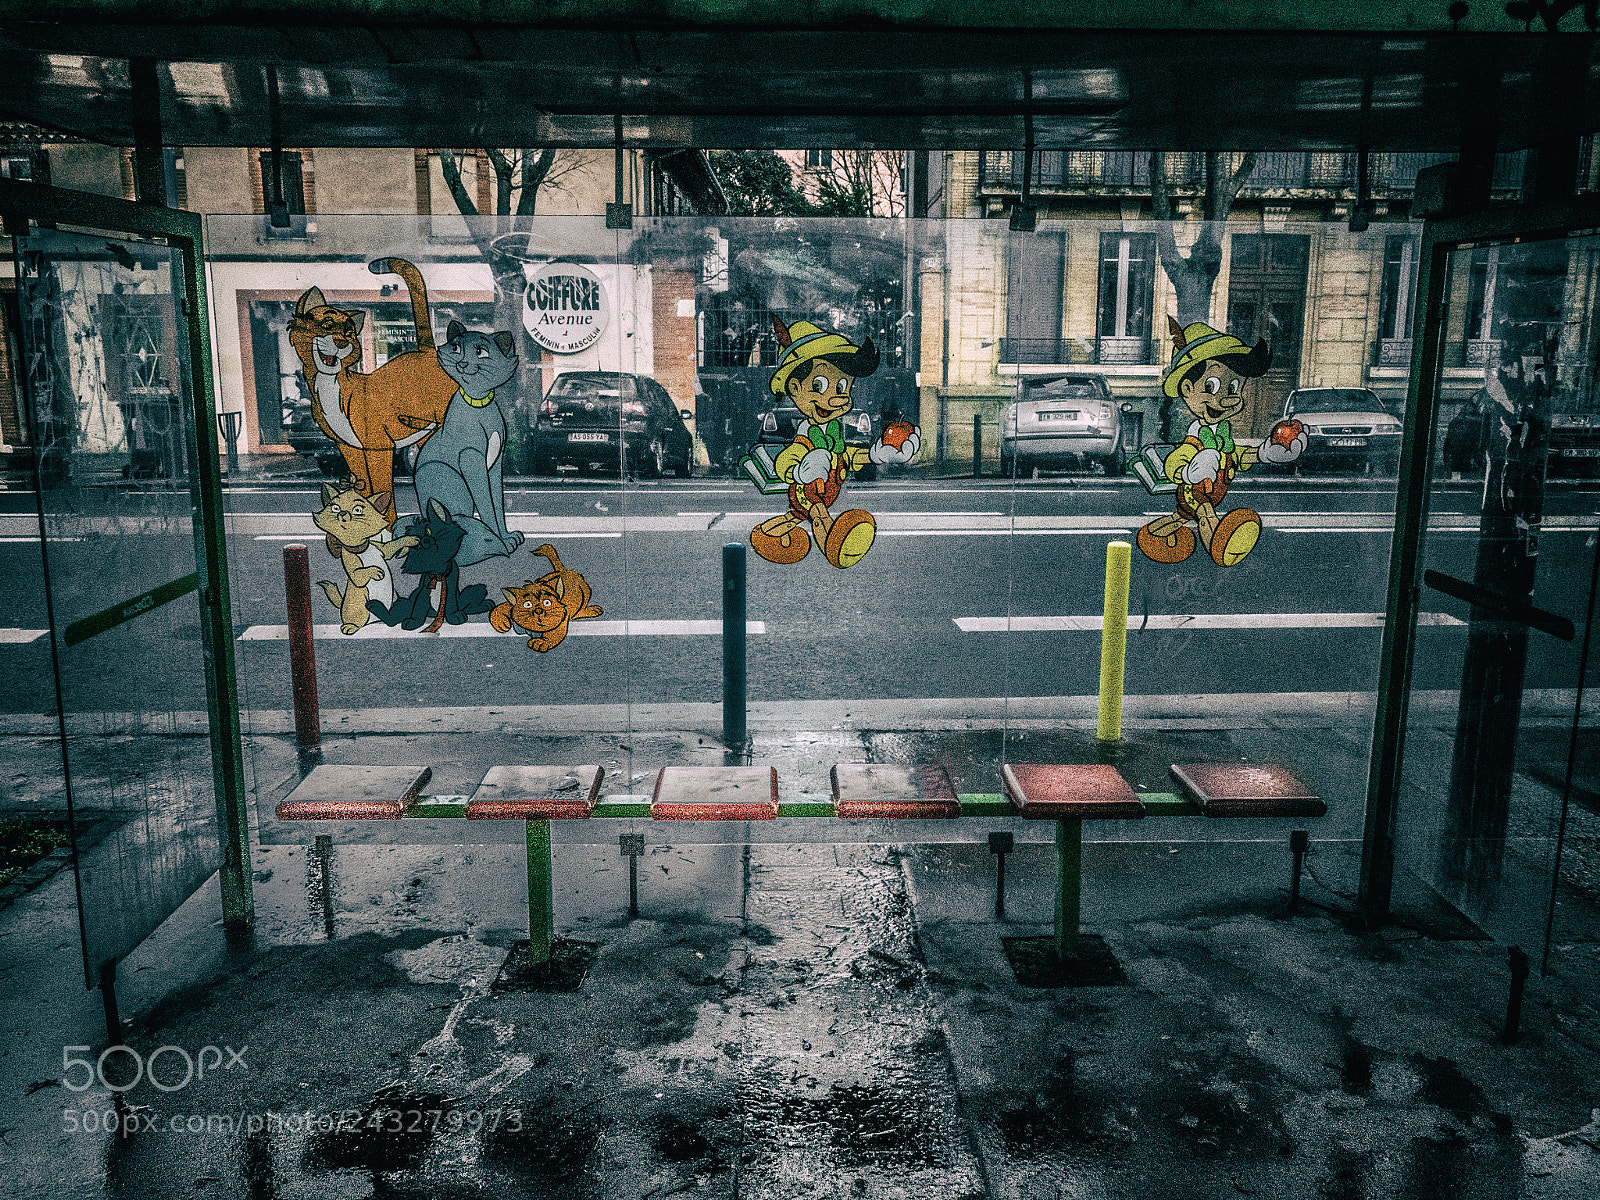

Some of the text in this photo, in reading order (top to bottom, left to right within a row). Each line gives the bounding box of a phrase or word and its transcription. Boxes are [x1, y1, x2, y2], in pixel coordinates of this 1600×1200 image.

[527, 275, 600, 312] COIFFURE
[538, 312, 593, 325] Avenue
[531, 326, 601, 350] FEMININ MASCULIN
